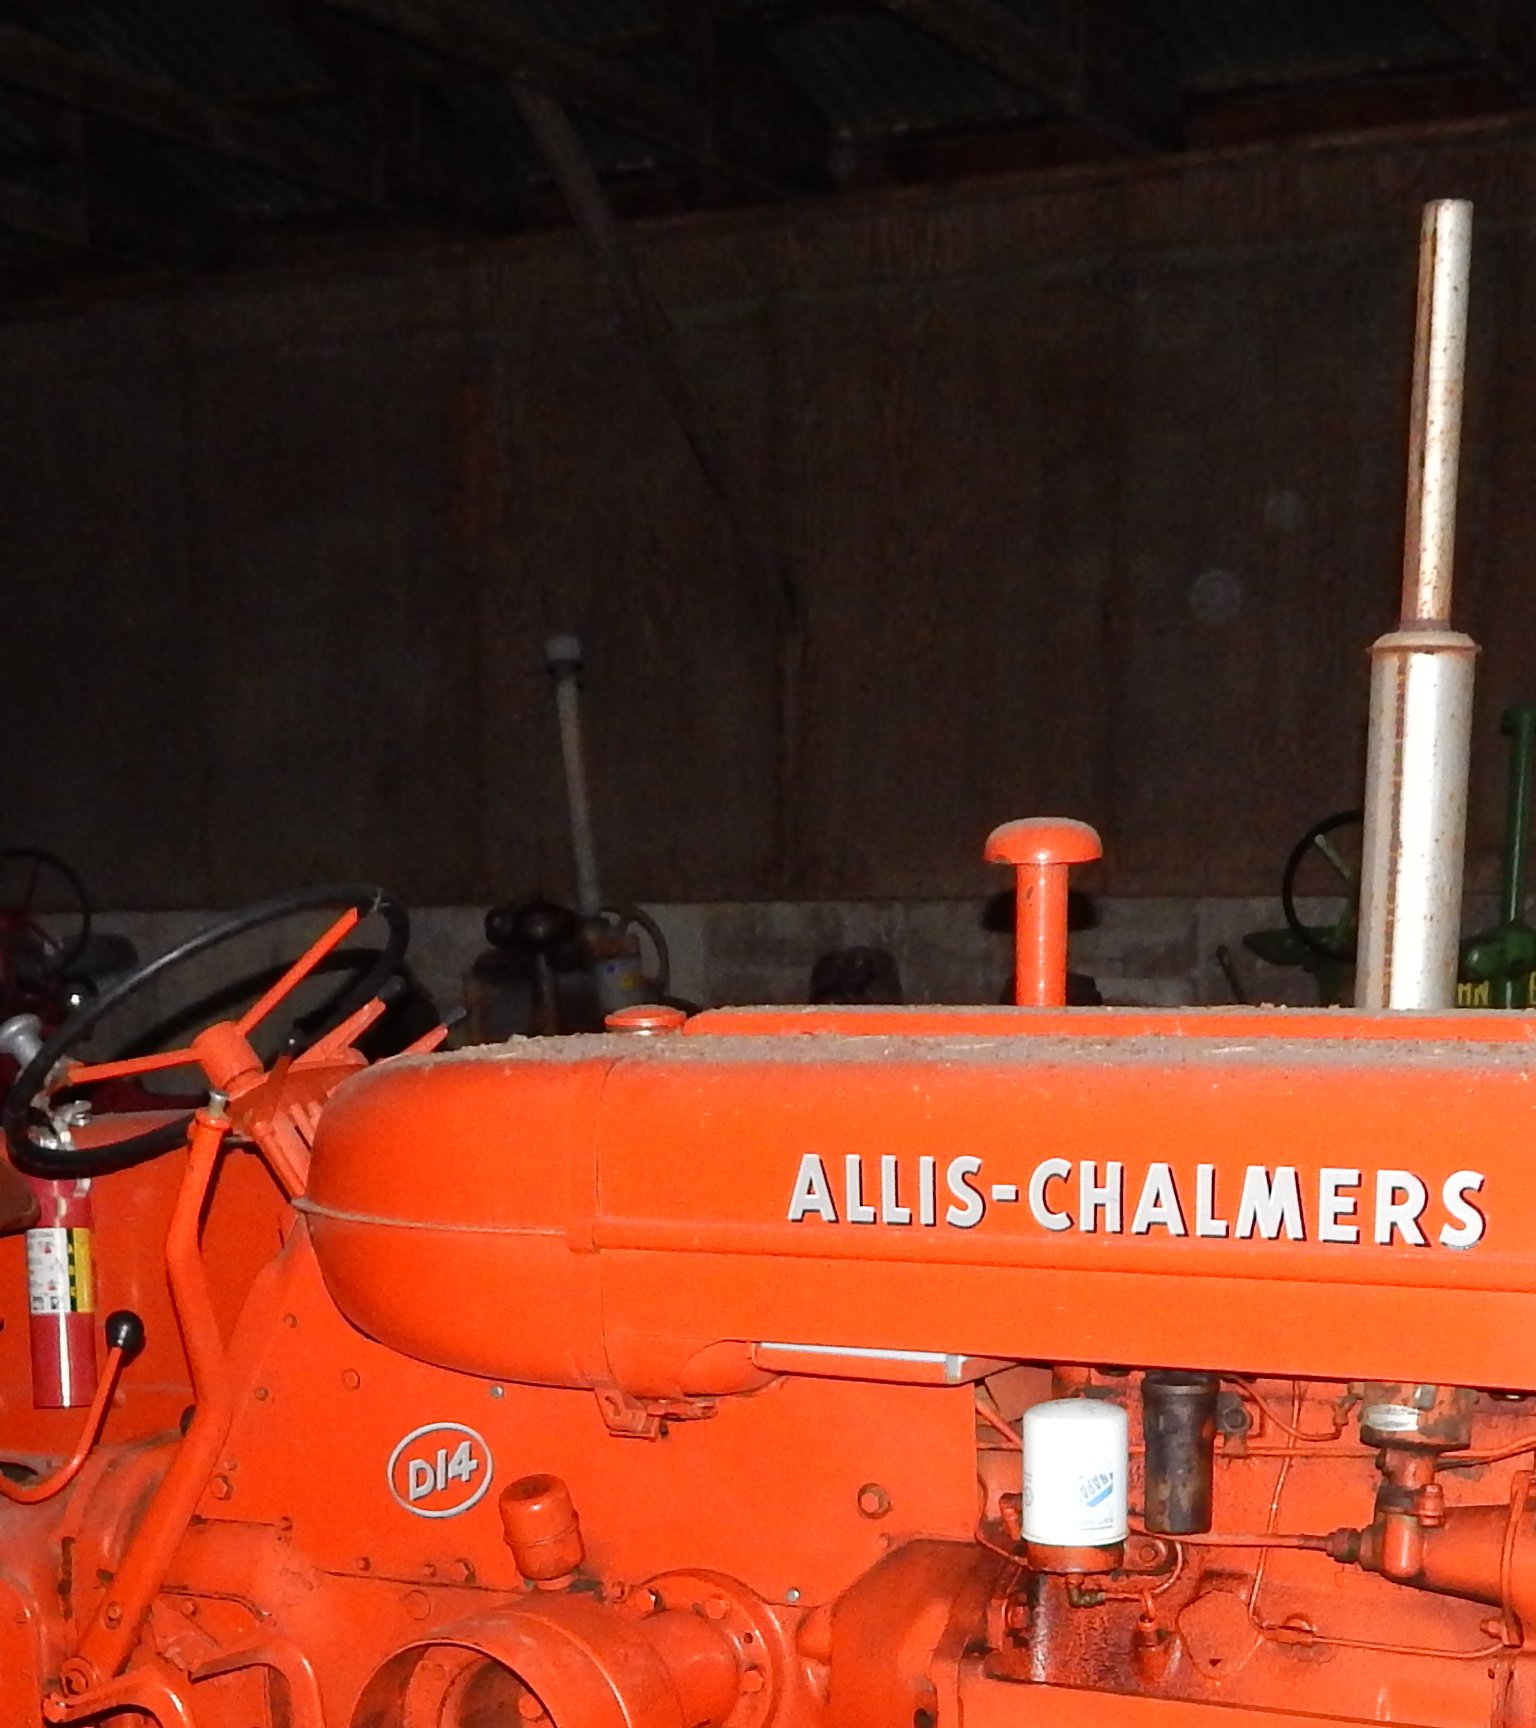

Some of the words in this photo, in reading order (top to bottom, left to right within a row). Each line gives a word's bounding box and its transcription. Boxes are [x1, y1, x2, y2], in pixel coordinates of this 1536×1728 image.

[788, 1153, 1487, 1249] ALLIS-CHALMERS
[409, 1441, 478, 1501] D14
[1080, 1473, 1110, 1499] NAPA
